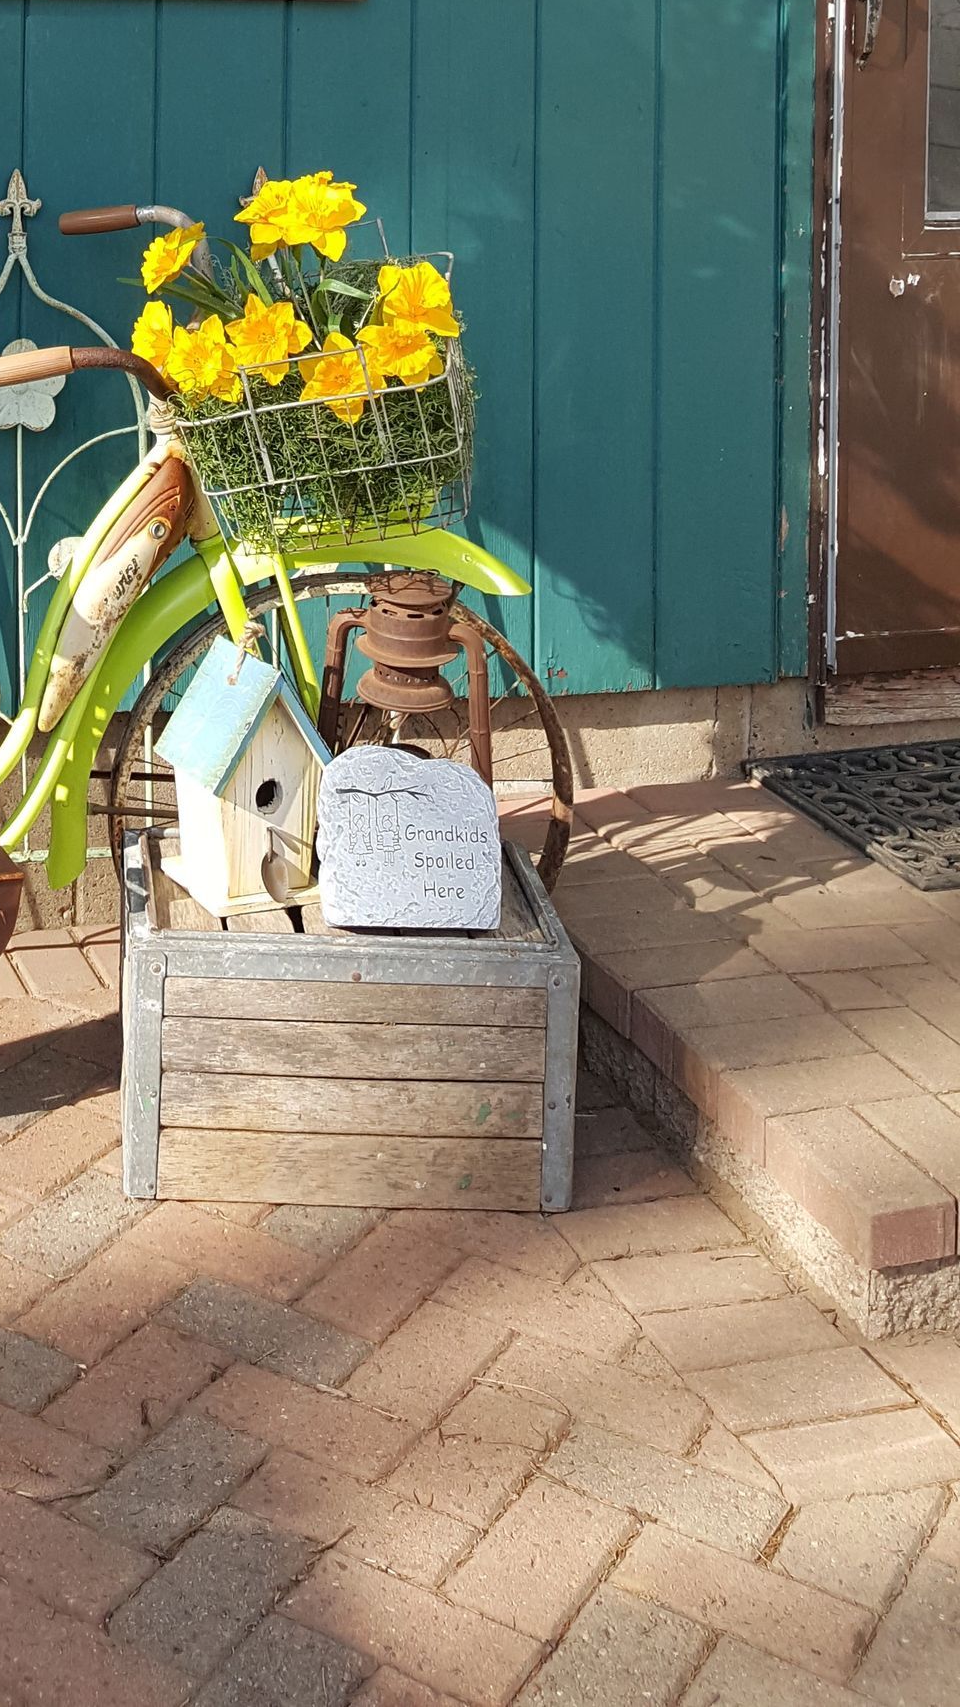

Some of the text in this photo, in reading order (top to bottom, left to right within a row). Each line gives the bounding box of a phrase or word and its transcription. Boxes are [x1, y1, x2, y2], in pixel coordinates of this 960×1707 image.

[404, 823, 489, 845] Grandkids
[414, 852, 476, 872] Spoiled
[423, 881, 466, 900] Here
